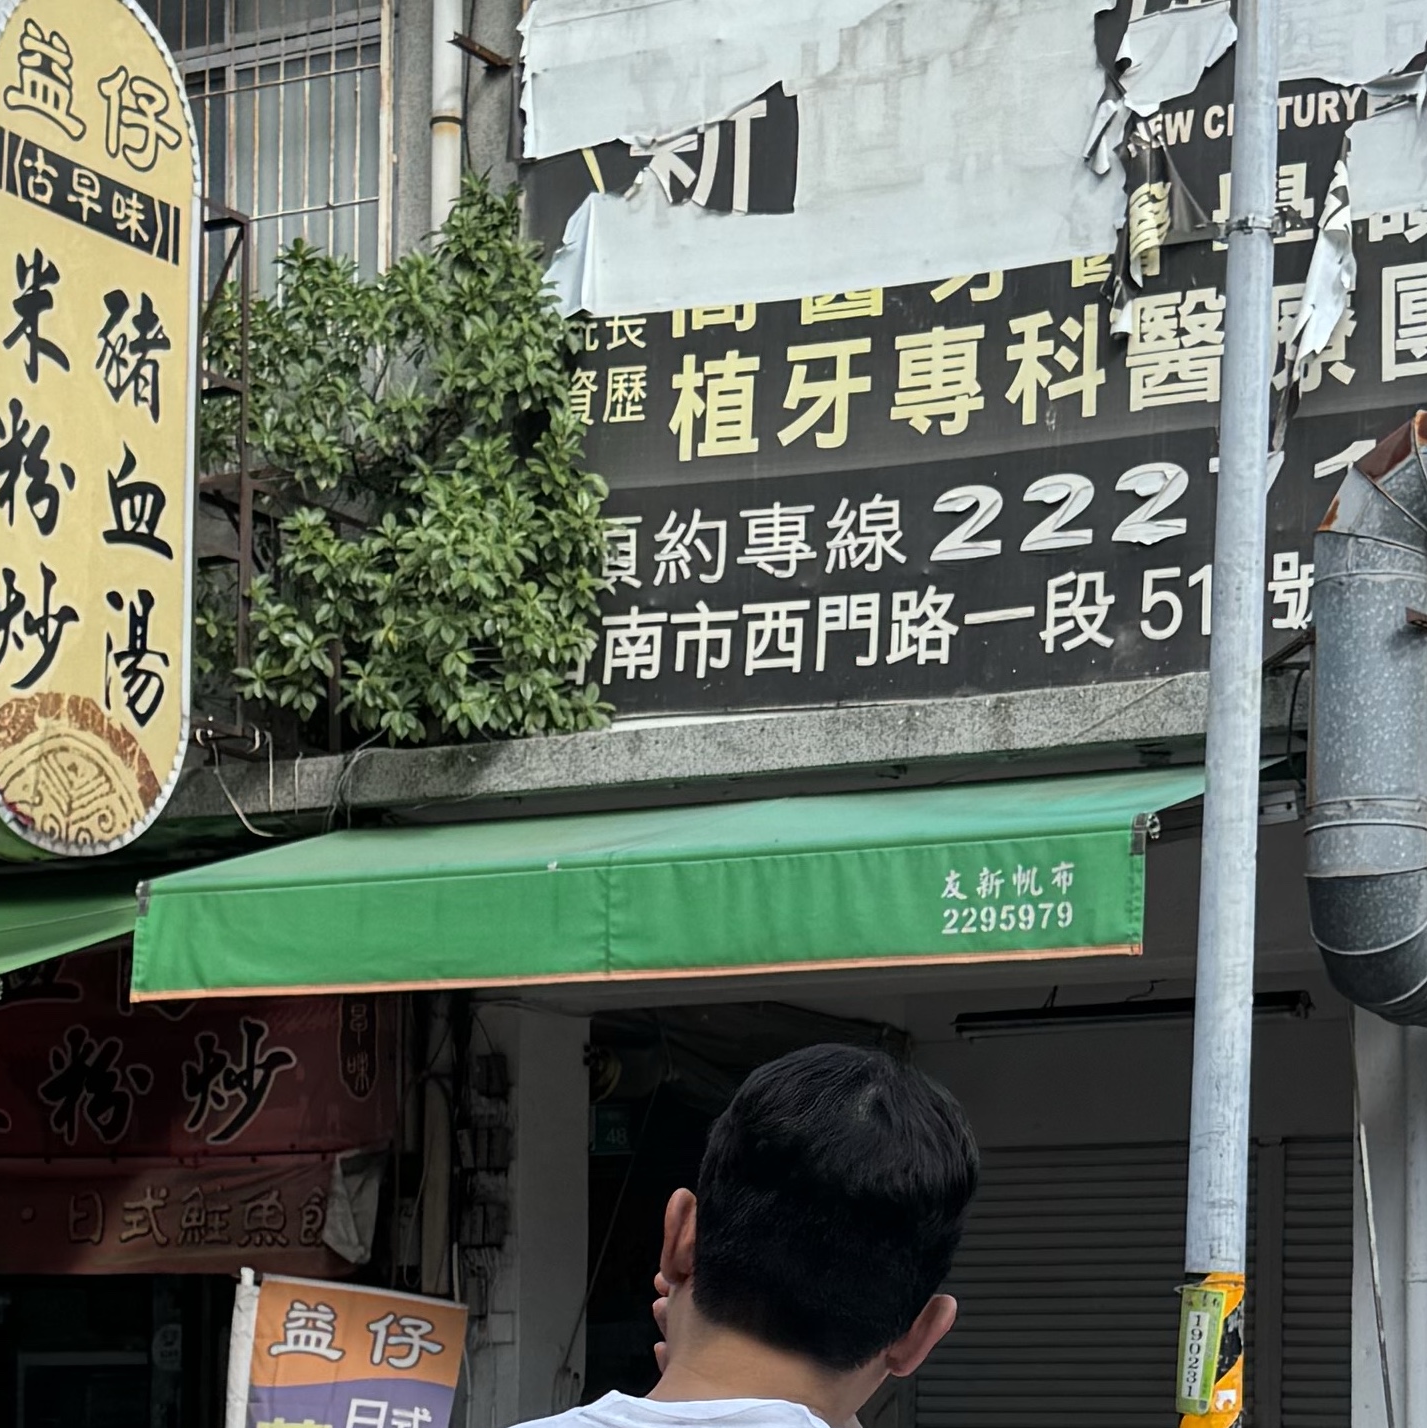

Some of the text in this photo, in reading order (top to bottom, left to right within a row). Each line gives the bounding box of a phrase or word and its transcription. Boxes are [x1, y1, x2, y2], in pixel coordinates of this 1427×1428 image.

[3, 20, 182, 172] 益仔
[1204, 86, 1361, 140] CTURY
[18, 149, 150, 247] 古早味
[94, 289, 175, 729] 豬血湯
[568, 568, 1116, 687] 南市西門路一段
[940, 861, 1076, 900] 友新帆布
[941, 901, 1074, 935] 2295979
[270, 1300, 444, 1370] 益仔
[1186, 1314, 1203, 1398] 190231
